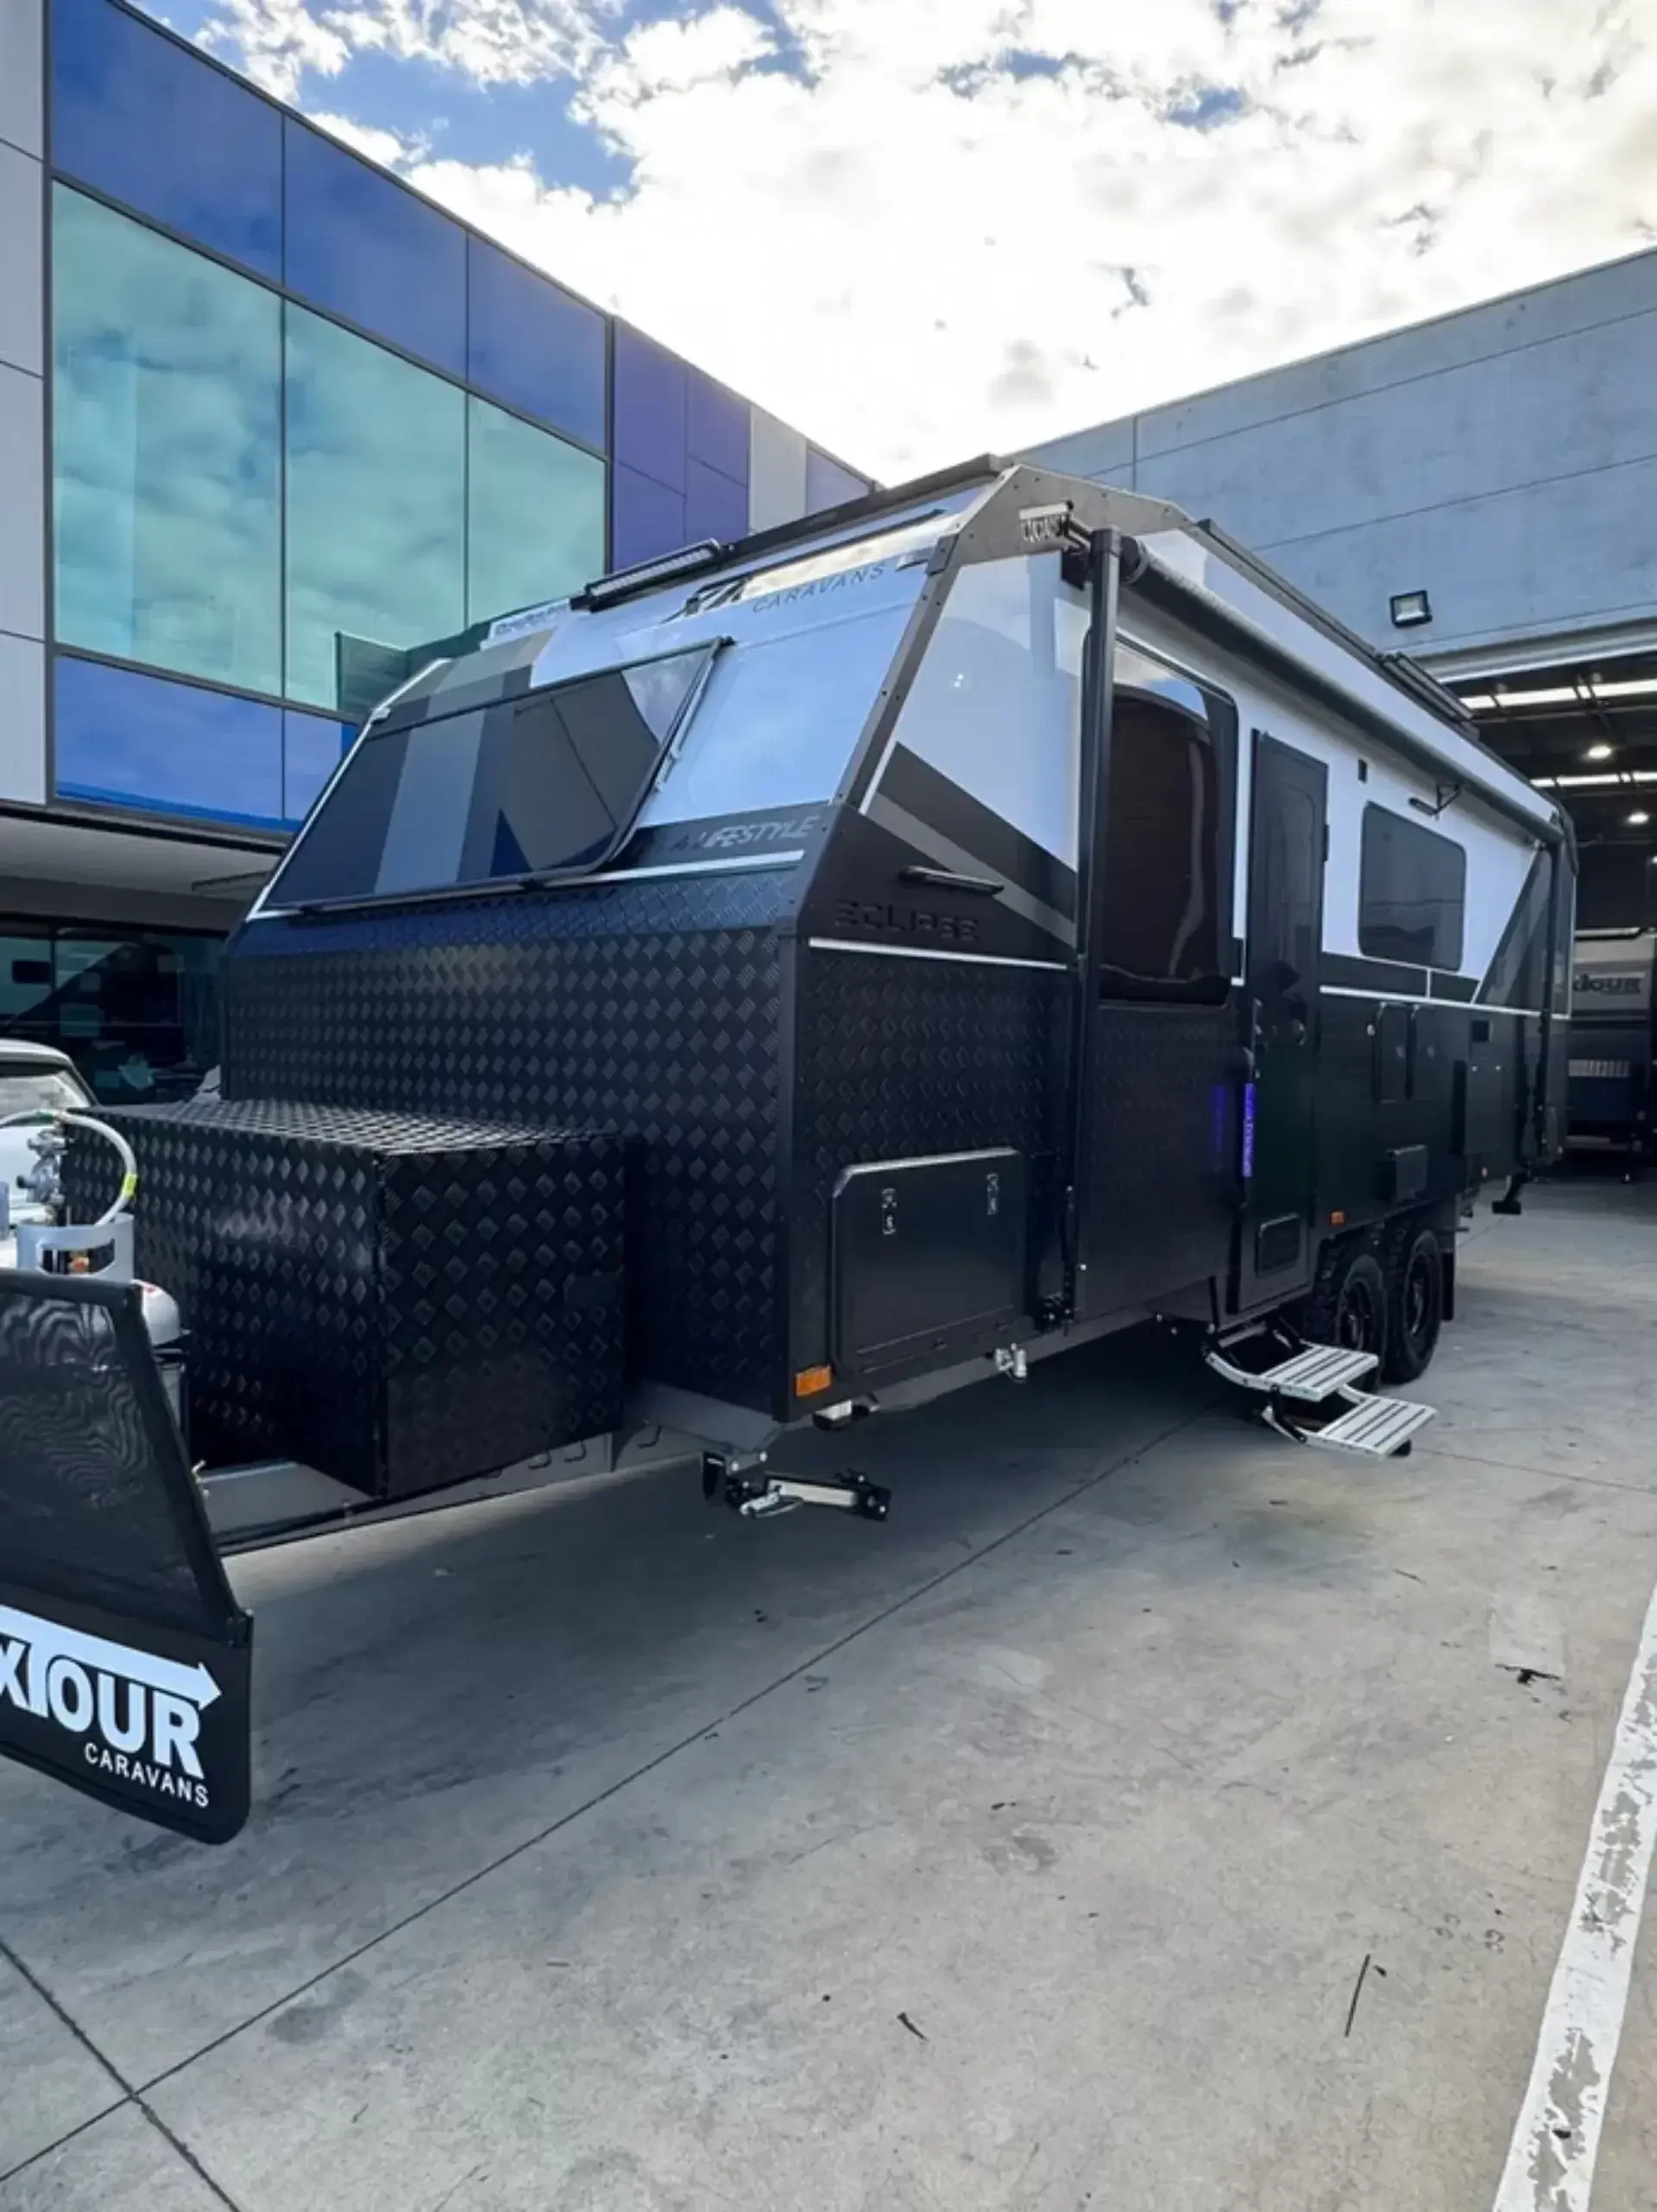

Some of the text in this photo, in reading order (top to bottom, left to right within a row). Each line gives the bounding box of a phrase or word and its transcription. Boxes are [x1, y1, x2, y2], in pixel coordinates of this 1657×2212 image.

[753, 564, 886, 613] CARAVANS
[834, 898, 982, 944] ECLIPSE
[84, 1742, 210, 1809] CARAVANS
